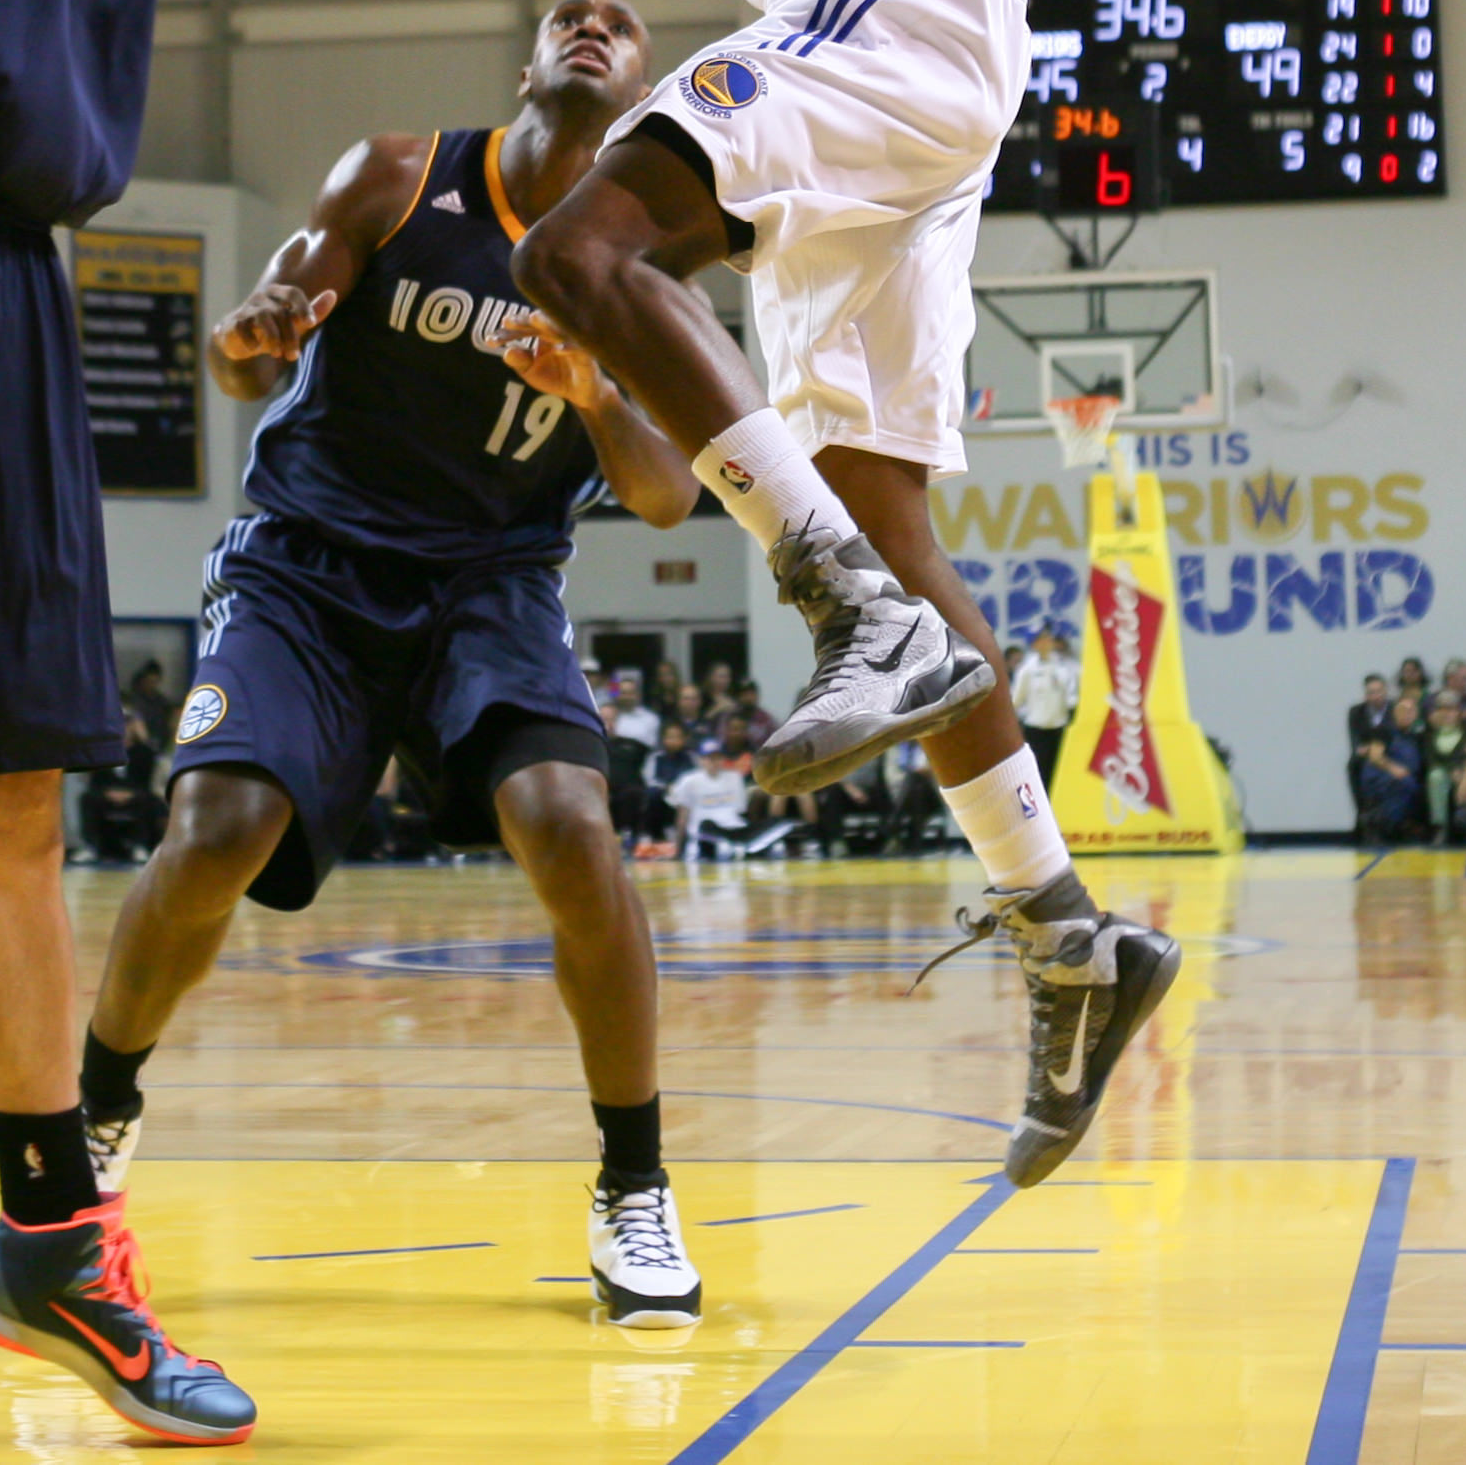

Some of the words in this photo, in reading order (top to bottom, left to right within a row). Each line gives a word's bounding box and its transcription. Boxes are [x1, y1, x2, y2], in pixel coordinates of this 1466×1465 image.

[717, 52, 758, 73] GOLDEN
[1320, 31, 1357, 63] 24
[1384, 33, 1394, 57] 1
[1411, 27, 1432, 60] 0
[1028, 60, 1078, 103] 45
[1241, 49, 1301, 98] 49
[1321, 72, 1358, 104] 22
[1385, 74, 1395, 98] 1
[1414, 70, 1434, 98] 4
[678, 75, 733, 120] WARRIORS
[1323, 113, 1360, 145] 21
[1387, 115, 1397, 139] 1
[1177, 137, 1204, 173] 4
[1280, 131, 1305, 172] 5
[1342, 154, 1364, 184] 9
[1380, 154, 1399, 183] 0
[1417, 150, 1437, 183] 2
[484, 380, 566, 462] 19
[1210, 432, 1251, 466] IS
[1098, 558, 1151, 825] Budweiser
